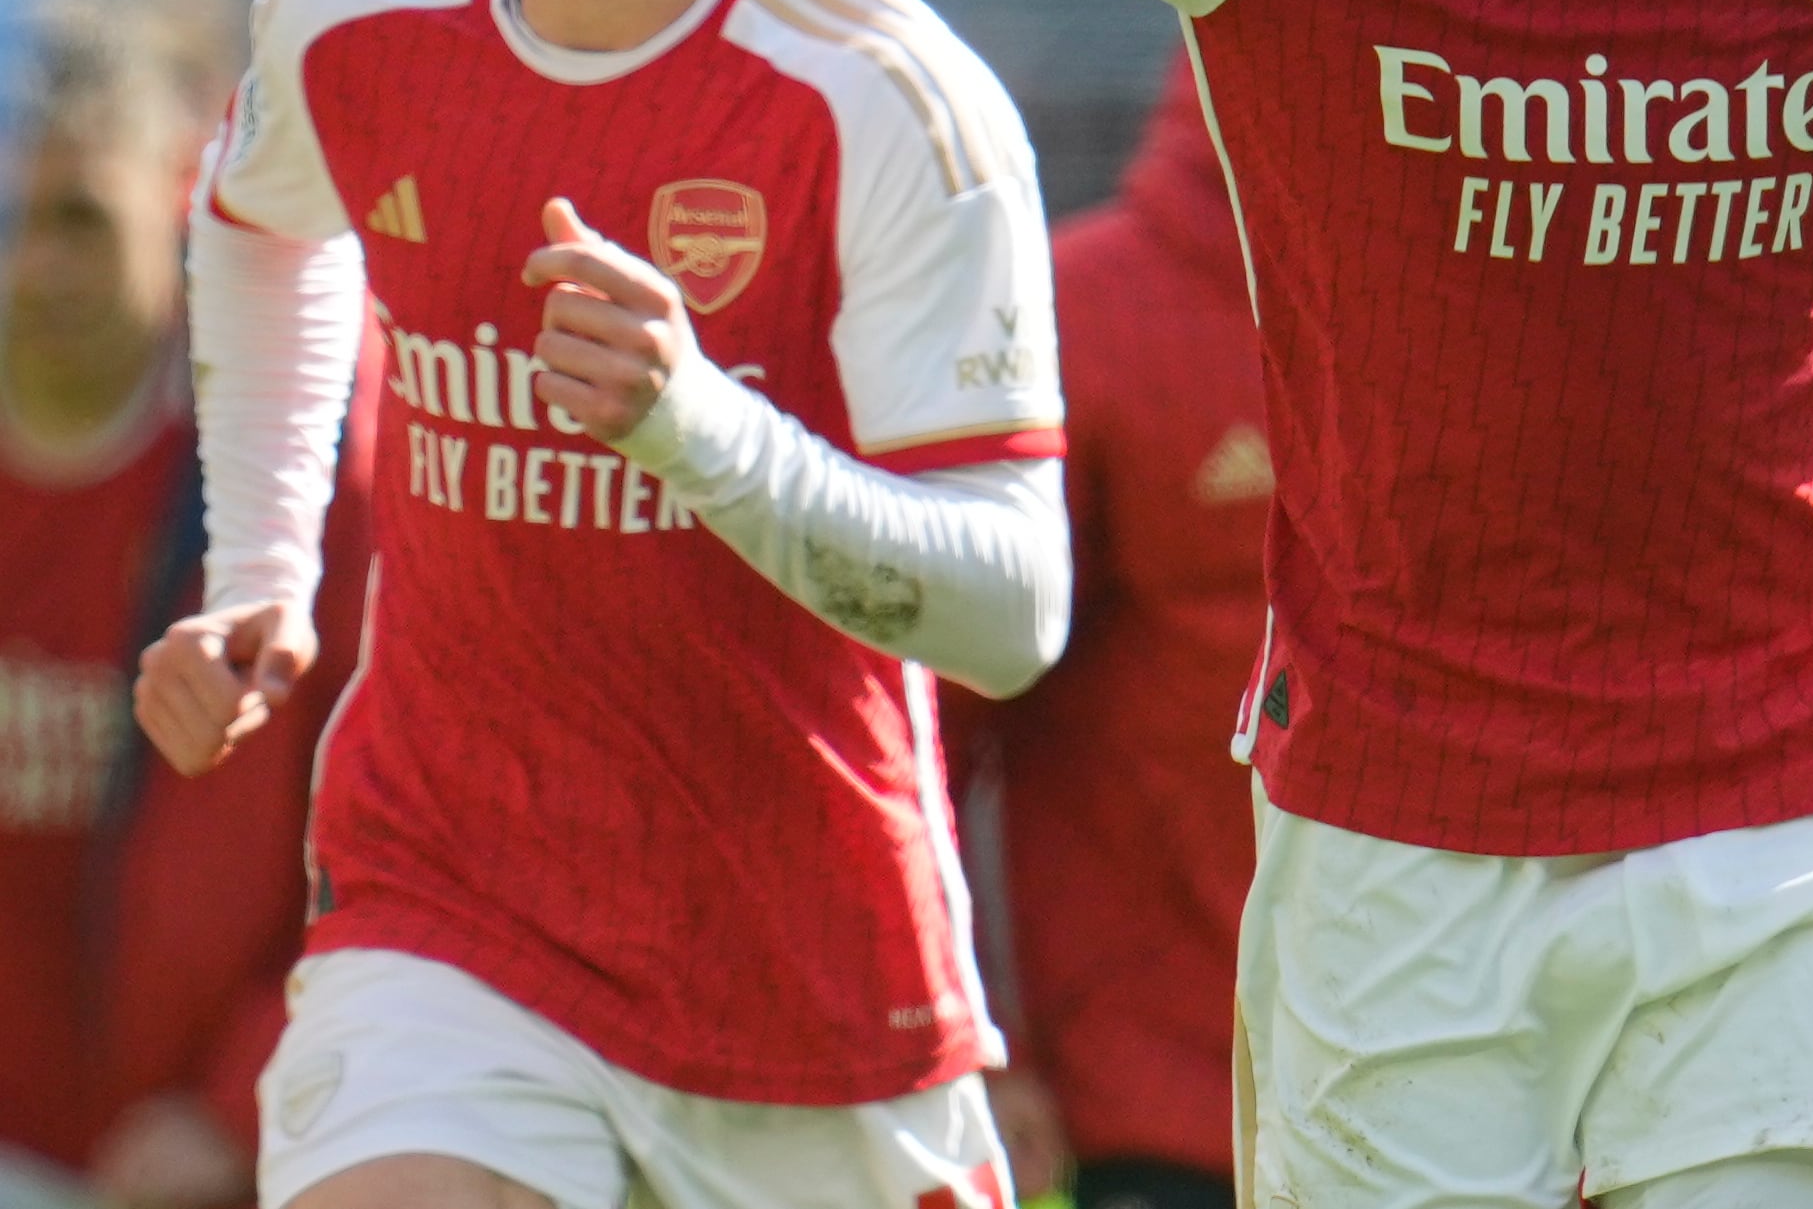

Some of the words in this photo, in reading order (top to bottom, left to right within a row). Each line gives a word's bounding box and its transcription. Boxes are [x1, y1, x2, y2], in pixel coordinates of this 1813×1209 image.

[1453, 176, 1565, 262] FLY
[1583, 172, 1813, 265] BETTER
[406, 421, 469, 512] FLY
